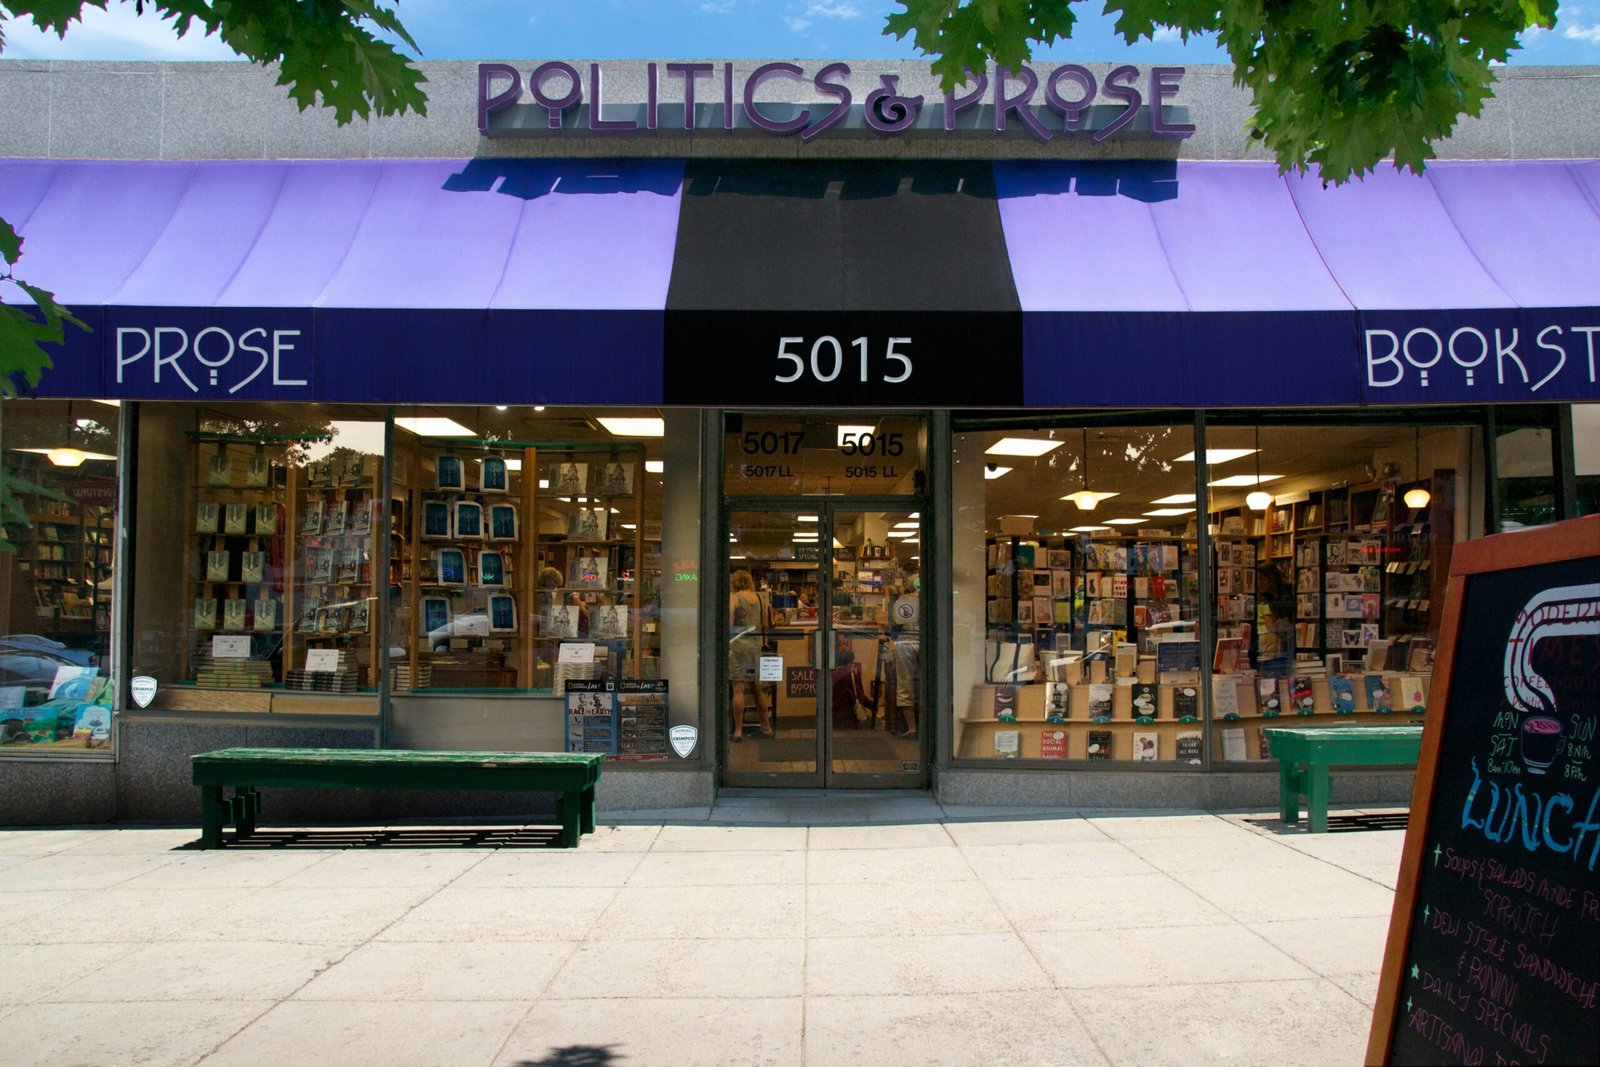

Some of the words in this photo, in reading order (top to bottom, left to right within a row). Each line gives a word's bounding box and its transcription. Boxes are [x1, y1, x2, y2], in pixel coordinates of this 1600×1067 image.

[478, 62, 852, 141] POLITICS
[864, 75, 924, 136] &
[943, 63, 1195, 143] PROSE
[117, 326, 308, 394] PROSE
[774, 335, 913, 383] 5015
[1365, 325, 1600, 392] BOOKST
[743, 431, 805, 454] 5017
[841, 433, 904, 457] 5015
[745, 465, 777, 478] 5017
[779, 466, 794, 477] LL
[845, 466, 877, 478] 5015
[883, 466, 898, 478] LL
[791, 671, 814, 681] SALE
[1490, 734, 1518, 757] SAT
[1568, 713, 1597, 742] SUN
[1461, 755, 1600, 872] LUNCH
[1487, 859, 1536, 893] SALADS
[1433, 906, 1460, 937] DELI
[1466, 920, 1511, 961] STYLE
[1484, 888, 1560, 945] SCRATCH
[1475, 997, 1551, 1064] SPECIALS
